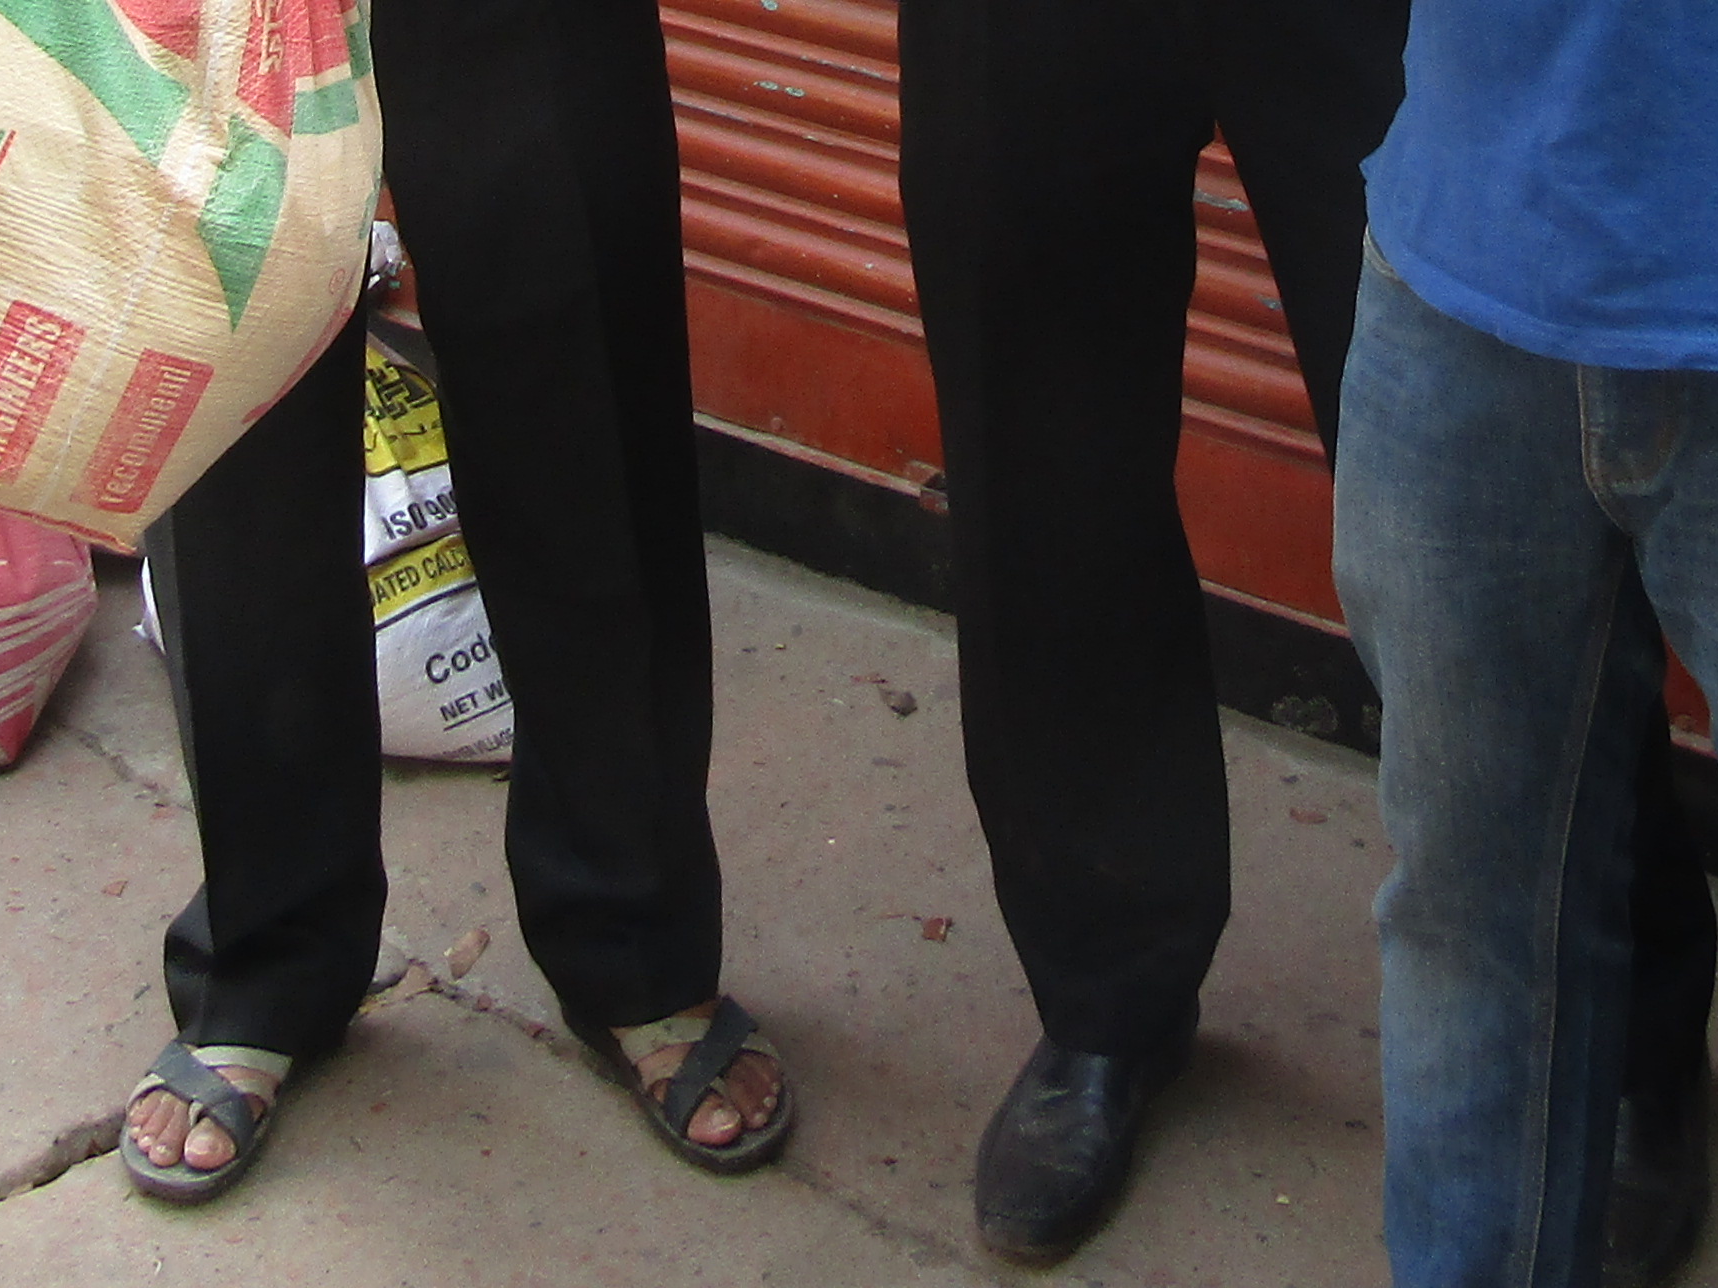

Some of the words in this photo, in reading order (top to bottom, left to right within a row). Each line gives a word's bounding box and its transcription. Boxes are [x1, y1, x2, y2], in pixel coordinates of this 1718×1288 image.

[380, 502, 429, 541] ISO
[372, 565, 421, 604] ATED
[422, 547, 467, 579] CALC
[425, 631, 492, 684] Cod
[439, 689, 480, 722] NET
